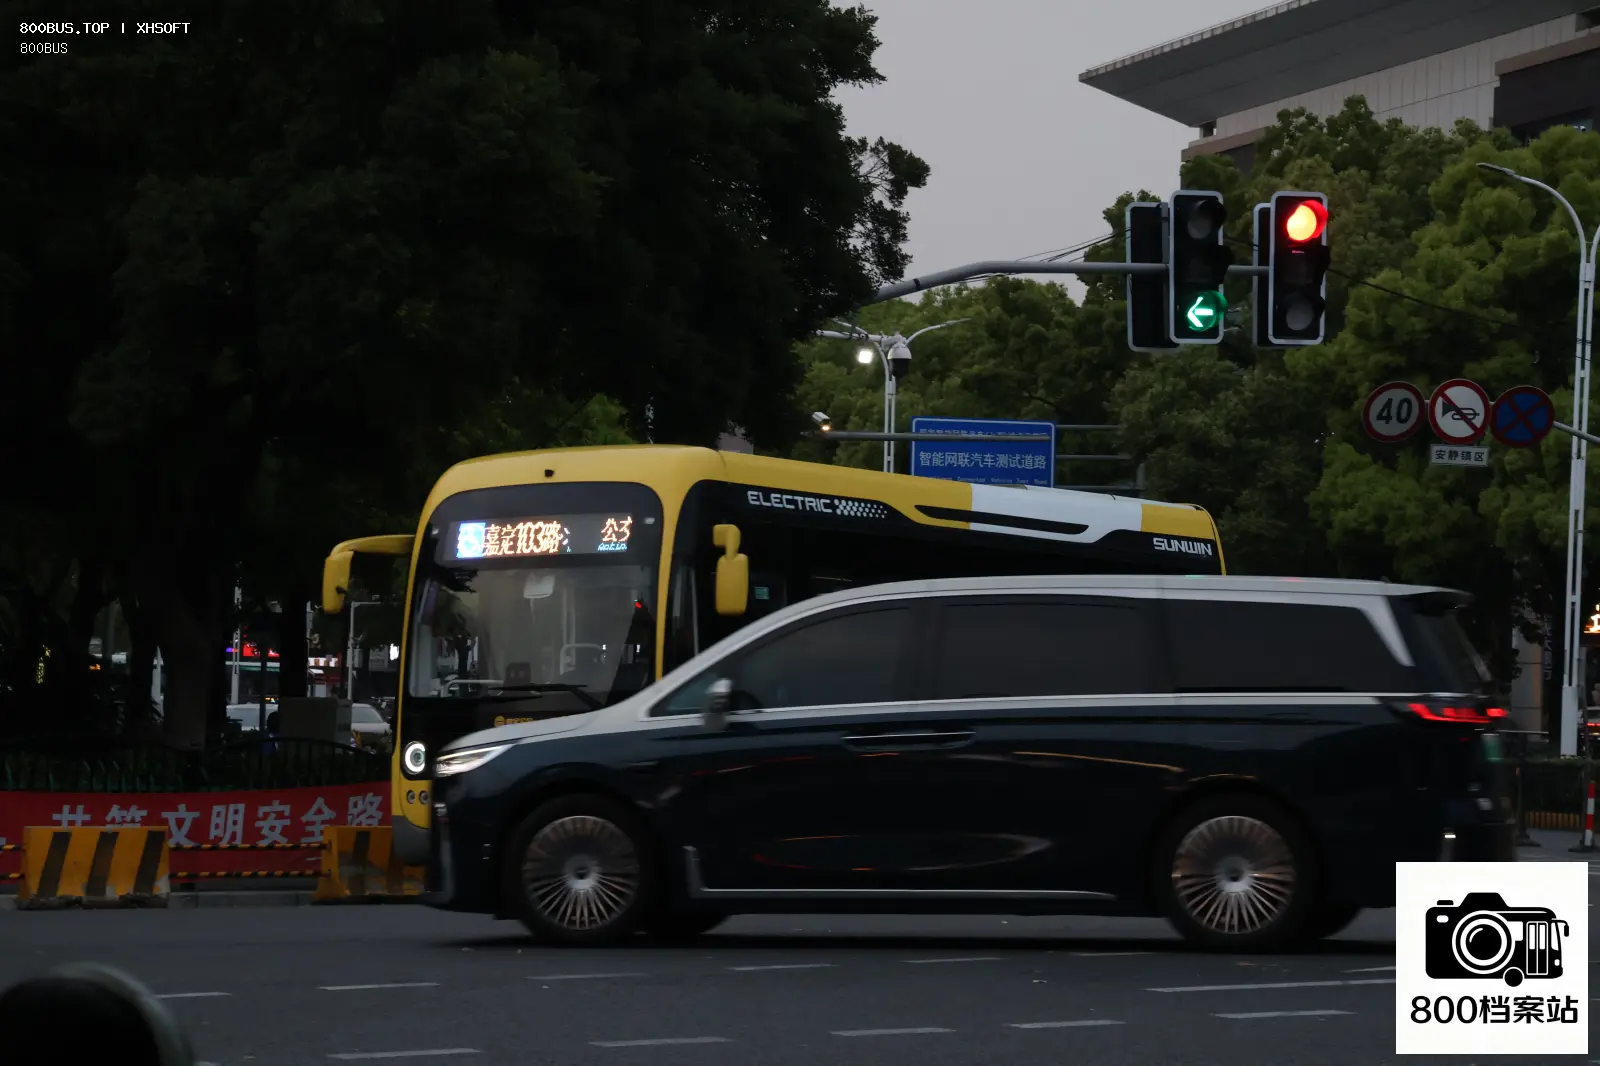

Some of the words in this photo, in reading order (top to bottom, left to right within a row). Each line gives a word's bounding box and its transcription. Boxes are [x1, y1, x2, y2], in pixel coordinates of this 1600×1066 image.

[1376, 398, 1413, 424] 40
[919, 450, 1048, 470] 智能网联汽车测试道路
[746, 490, 833, 513] ELECTRIC
[1152, 537, 1213, 556] SUNWIN
